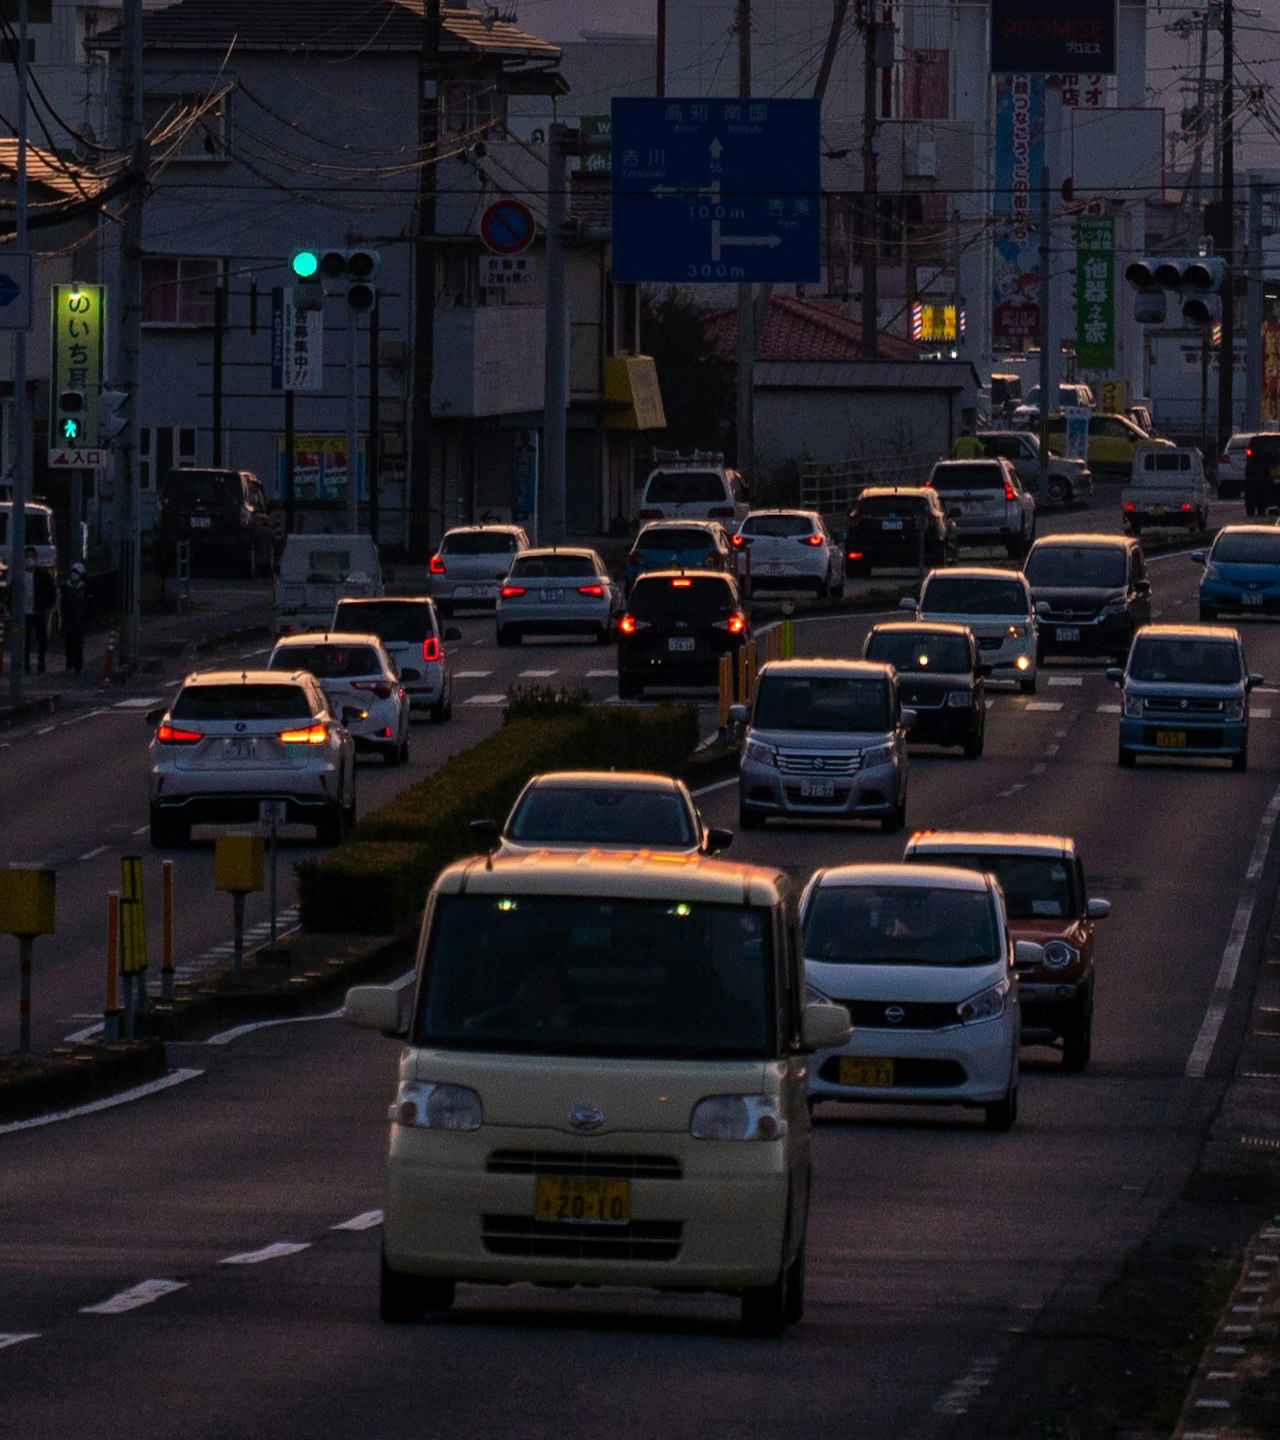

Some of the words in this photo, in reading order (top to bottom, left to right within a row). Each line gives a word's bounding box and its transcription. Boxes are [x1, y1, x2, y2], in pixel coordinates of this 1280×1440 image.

[1065, 43, 1101, 54] プロミス
[665, 104, 708, 123] 高知
[724, 104, 768, 123] 南国
[72, 453, 100, 465] 入口
